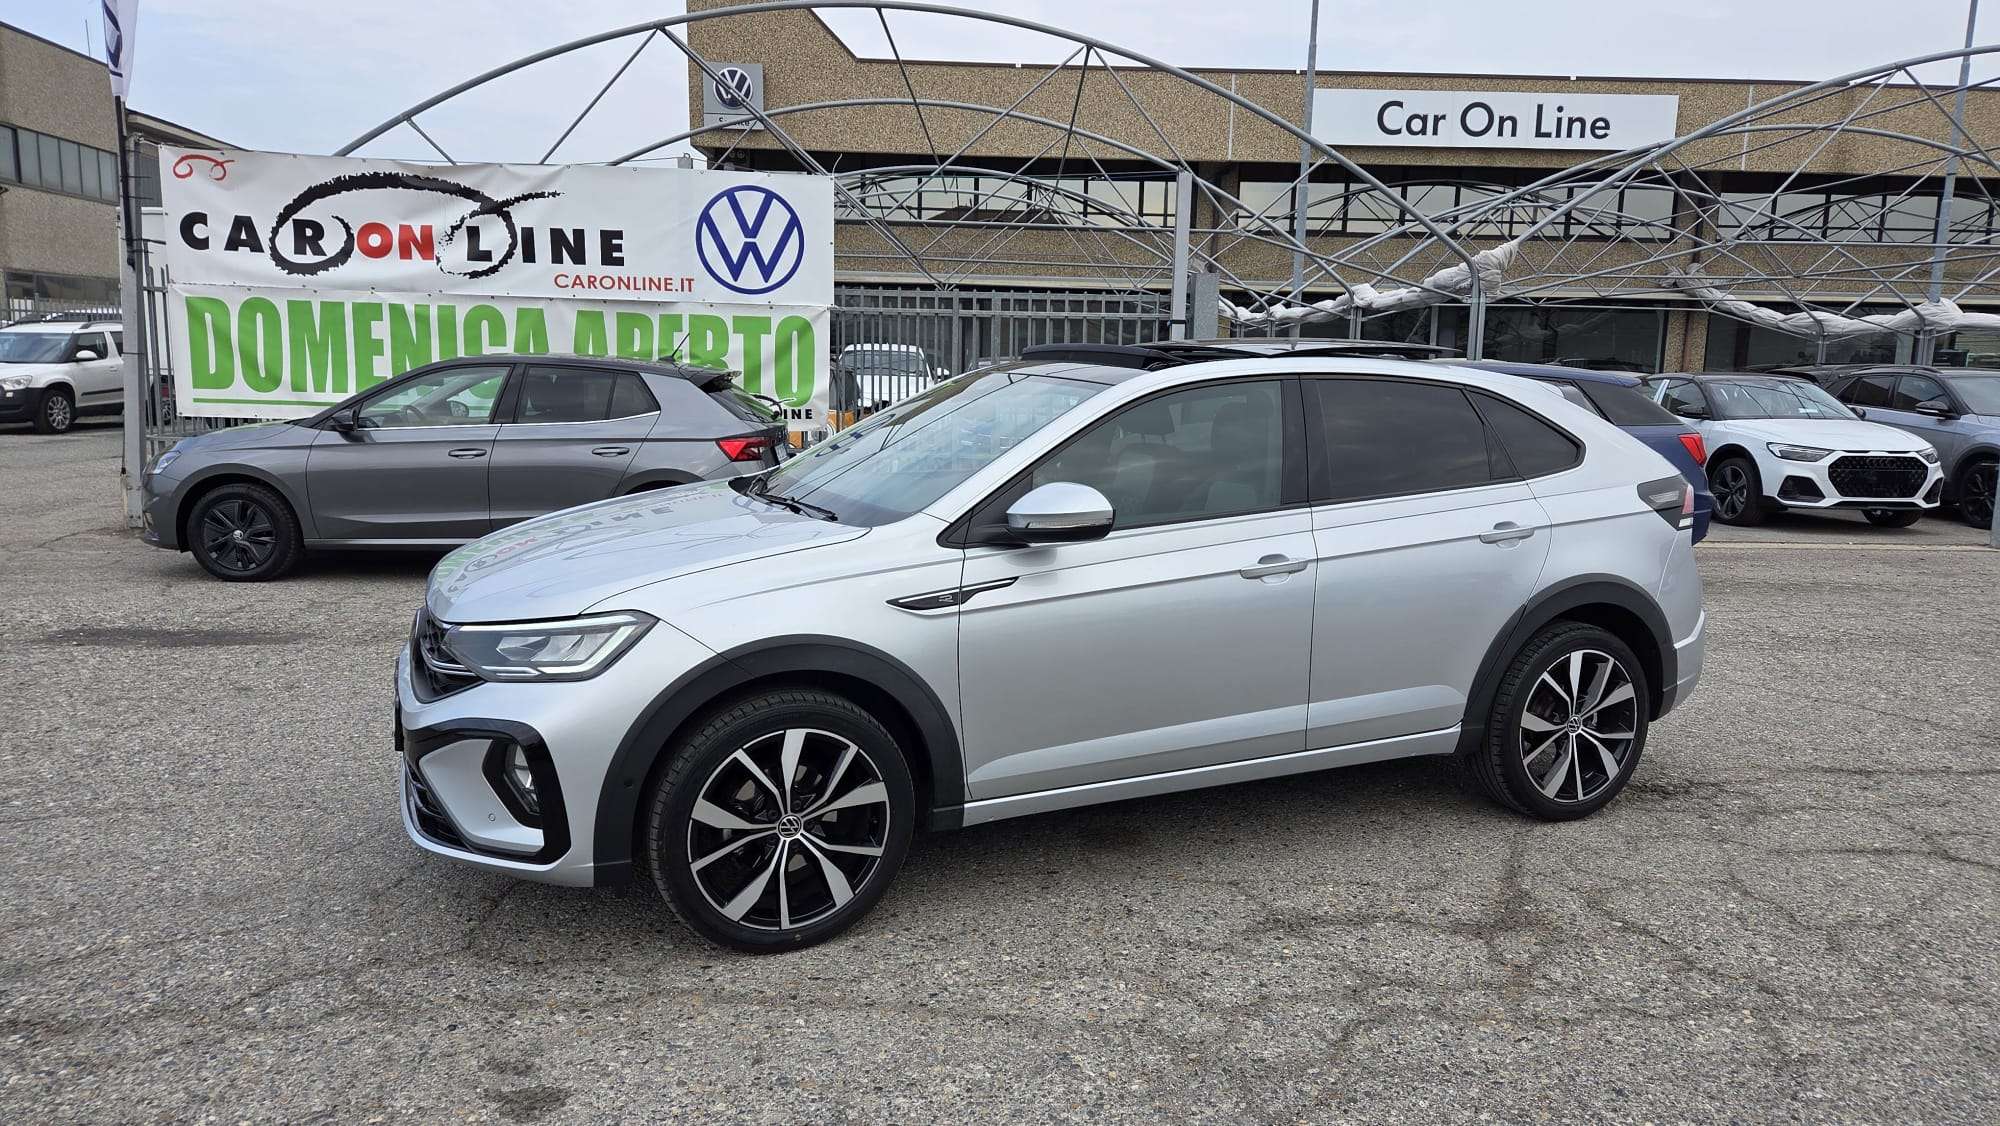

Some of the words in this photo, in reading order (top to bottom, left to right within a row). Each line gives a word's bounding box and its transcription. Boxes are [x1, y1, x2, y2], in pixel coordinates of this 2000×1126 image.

[1376, 101, 1446, 137] Car
[1460, 102, 1518, 138] On
[1535, 104, 1611, 139] Line
[554, 273, 695, 292] CARONLINE.IT
[185, 296, 549, 394] DOMENICA
[783, 408, 813, 420] INE
